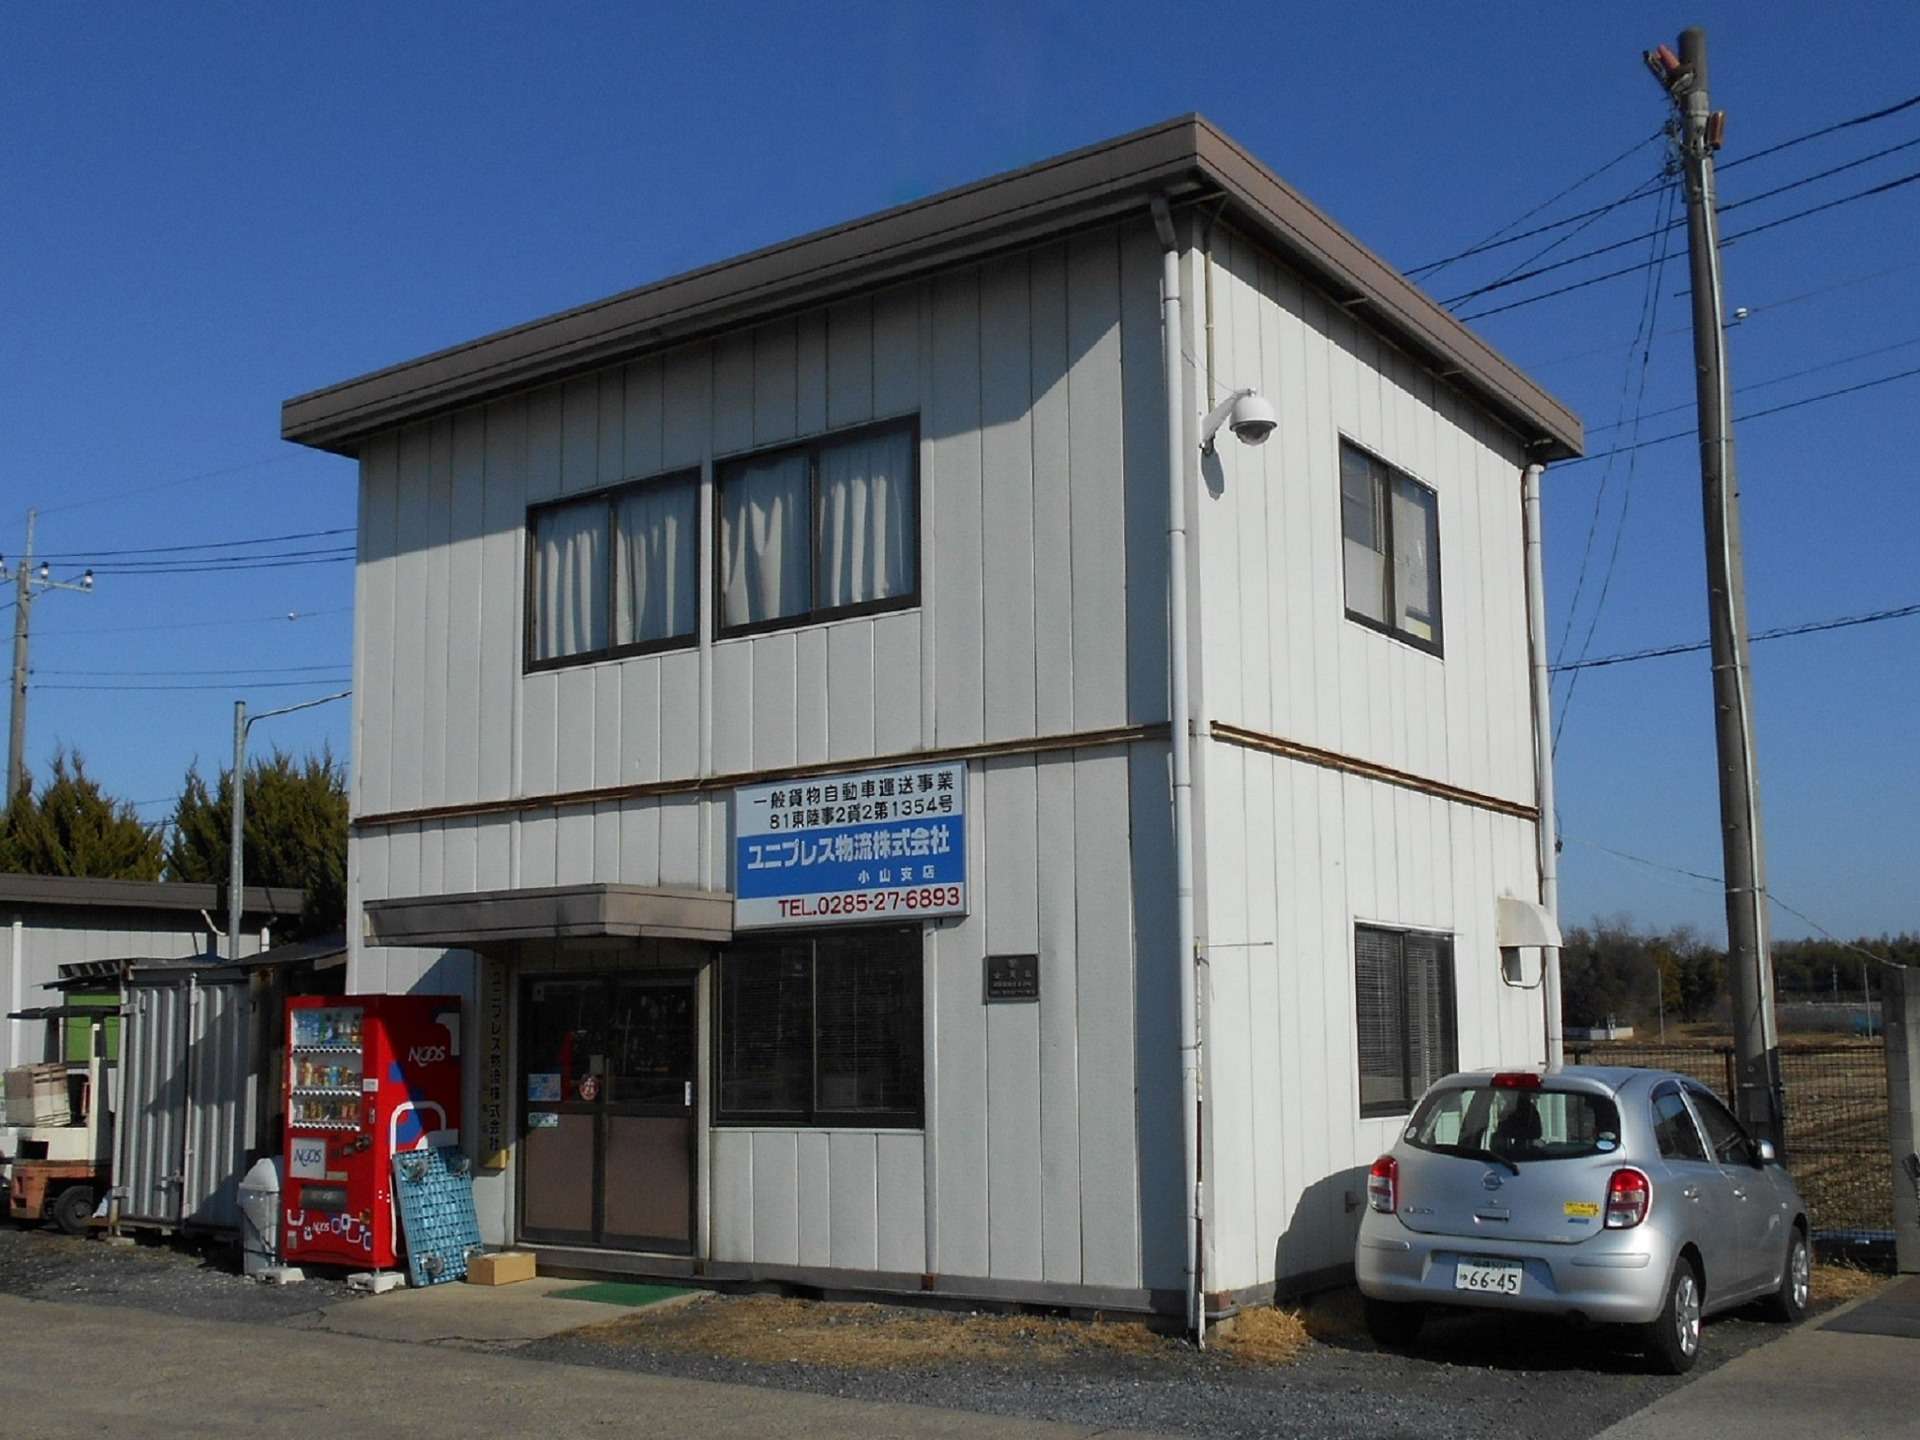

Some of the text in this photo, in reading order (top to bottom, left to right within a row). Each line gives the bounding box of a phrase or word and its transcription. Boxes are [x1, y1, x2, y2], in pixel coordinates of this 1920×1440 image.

[753, 771, 953, 809] 一般貨物自動車運送事業
[770, 794, 953, 830] 81東陸事2貨2第1354号
[747, 824, 950, 869] ユニプレス物流株式会社
[858, 864, 935, 884] 小山支店
[1470, 1270, 1518, 1292] 66-45
